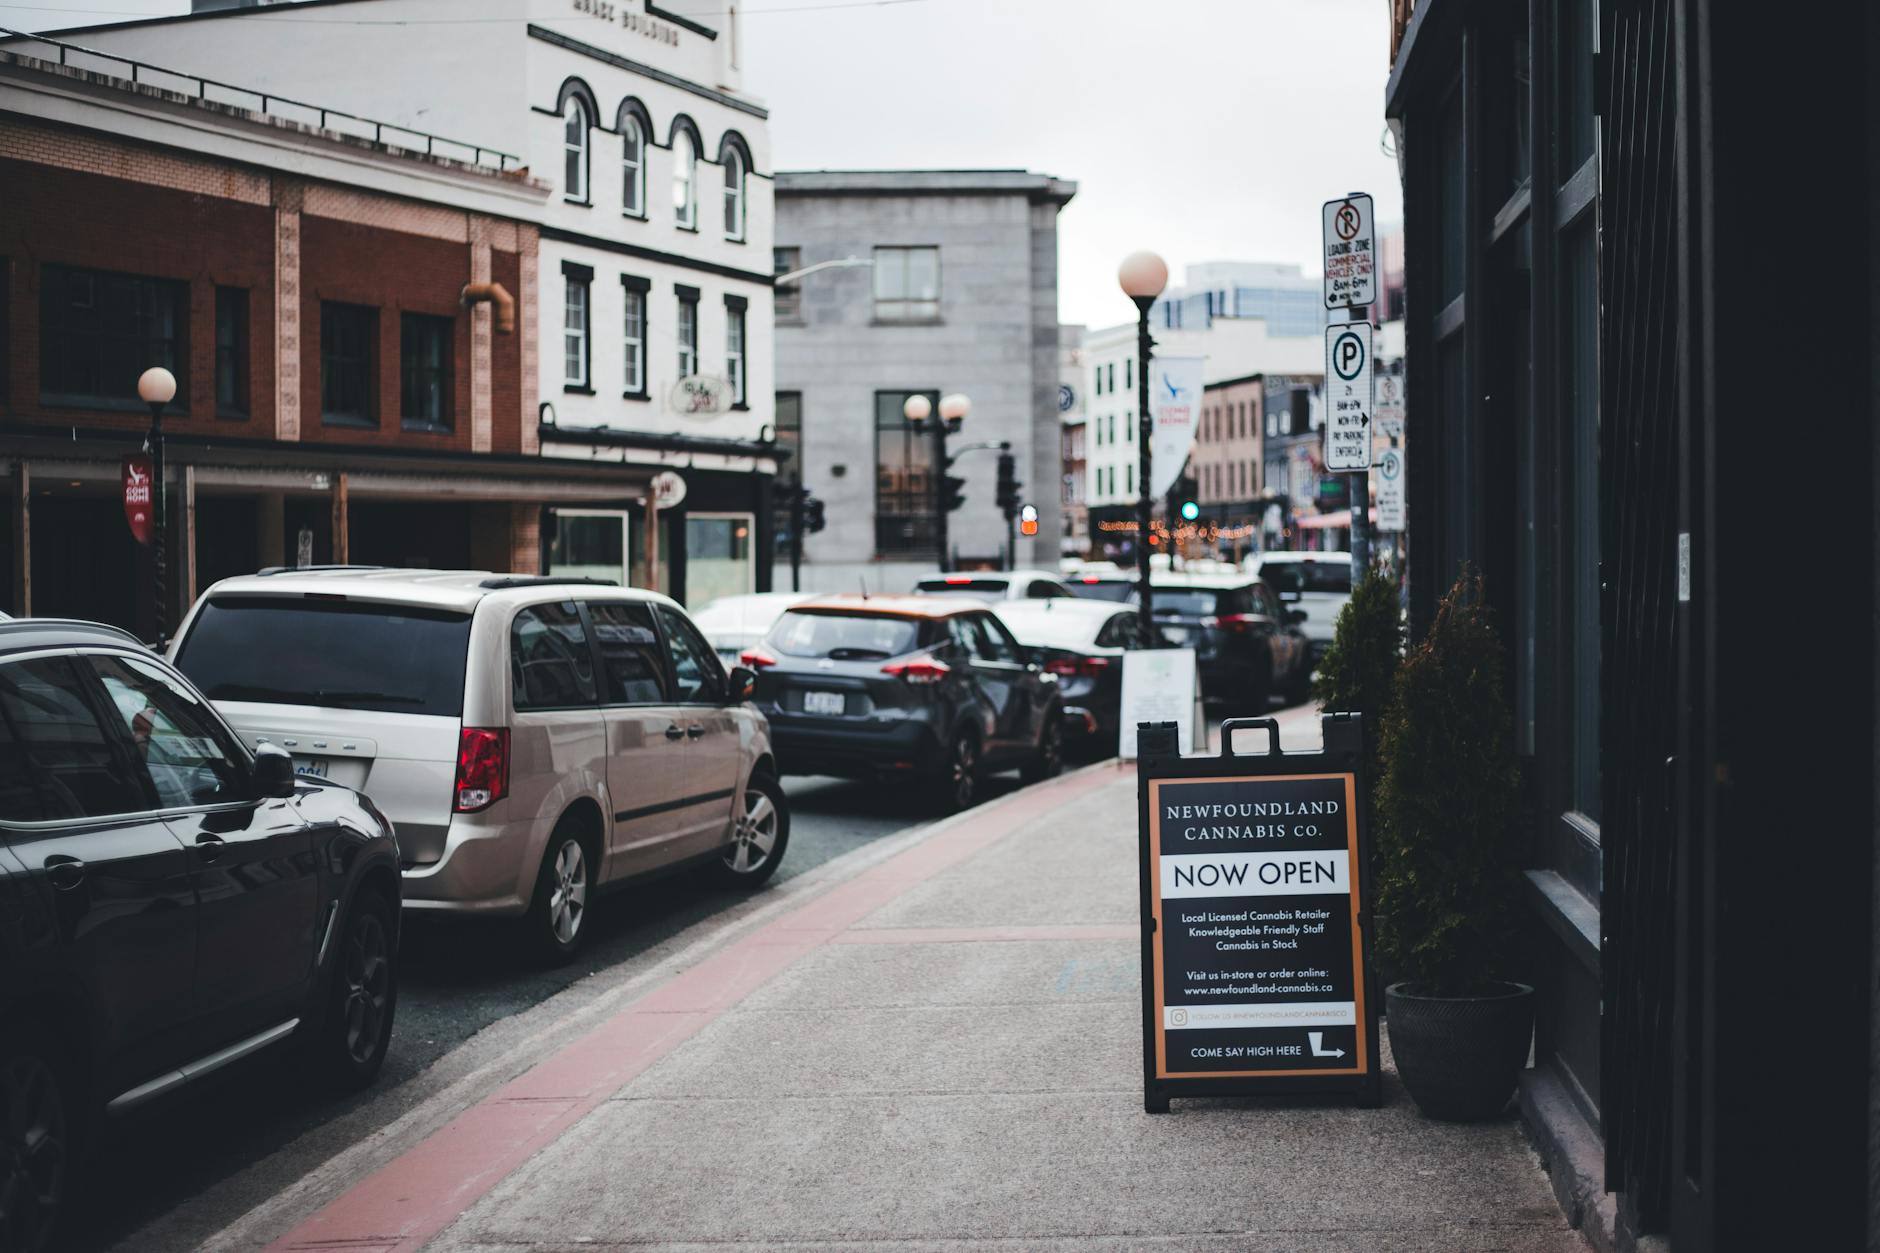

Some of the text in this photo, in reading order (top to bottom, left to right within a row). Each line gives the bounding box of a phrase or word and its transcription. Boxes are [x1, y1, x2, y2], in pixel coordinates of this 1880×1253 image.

[1328, 238, 1370, 257] LOADING ZONE
[1327, 254, 1370, 268] COMMERCIAL
[1326, 264, 1373, 279] VEHICLES ONLY
[1167, 801, 1339, 819] NEWFOUNDLAND
[1184, 824, 1322, 841] CANNABIS CO.
[1174, 860, 1336, 888] NOW OPEN
[1182, 909, 1331, 923] Local Licensed Cannabis Retailer
[1188, 923, 1325, 938] Knowledgeable Friendly Staff
[1216, 939, 1298, 951] Cannabis in Stock
[1186, 967, 1329, 981] Visit us in-store or order online:
[1184, 982, 1333, 995] www.newfoundland-cannabis.ca
[1190, 1045, 1302, 1058] COME SAY HIGH HERE
